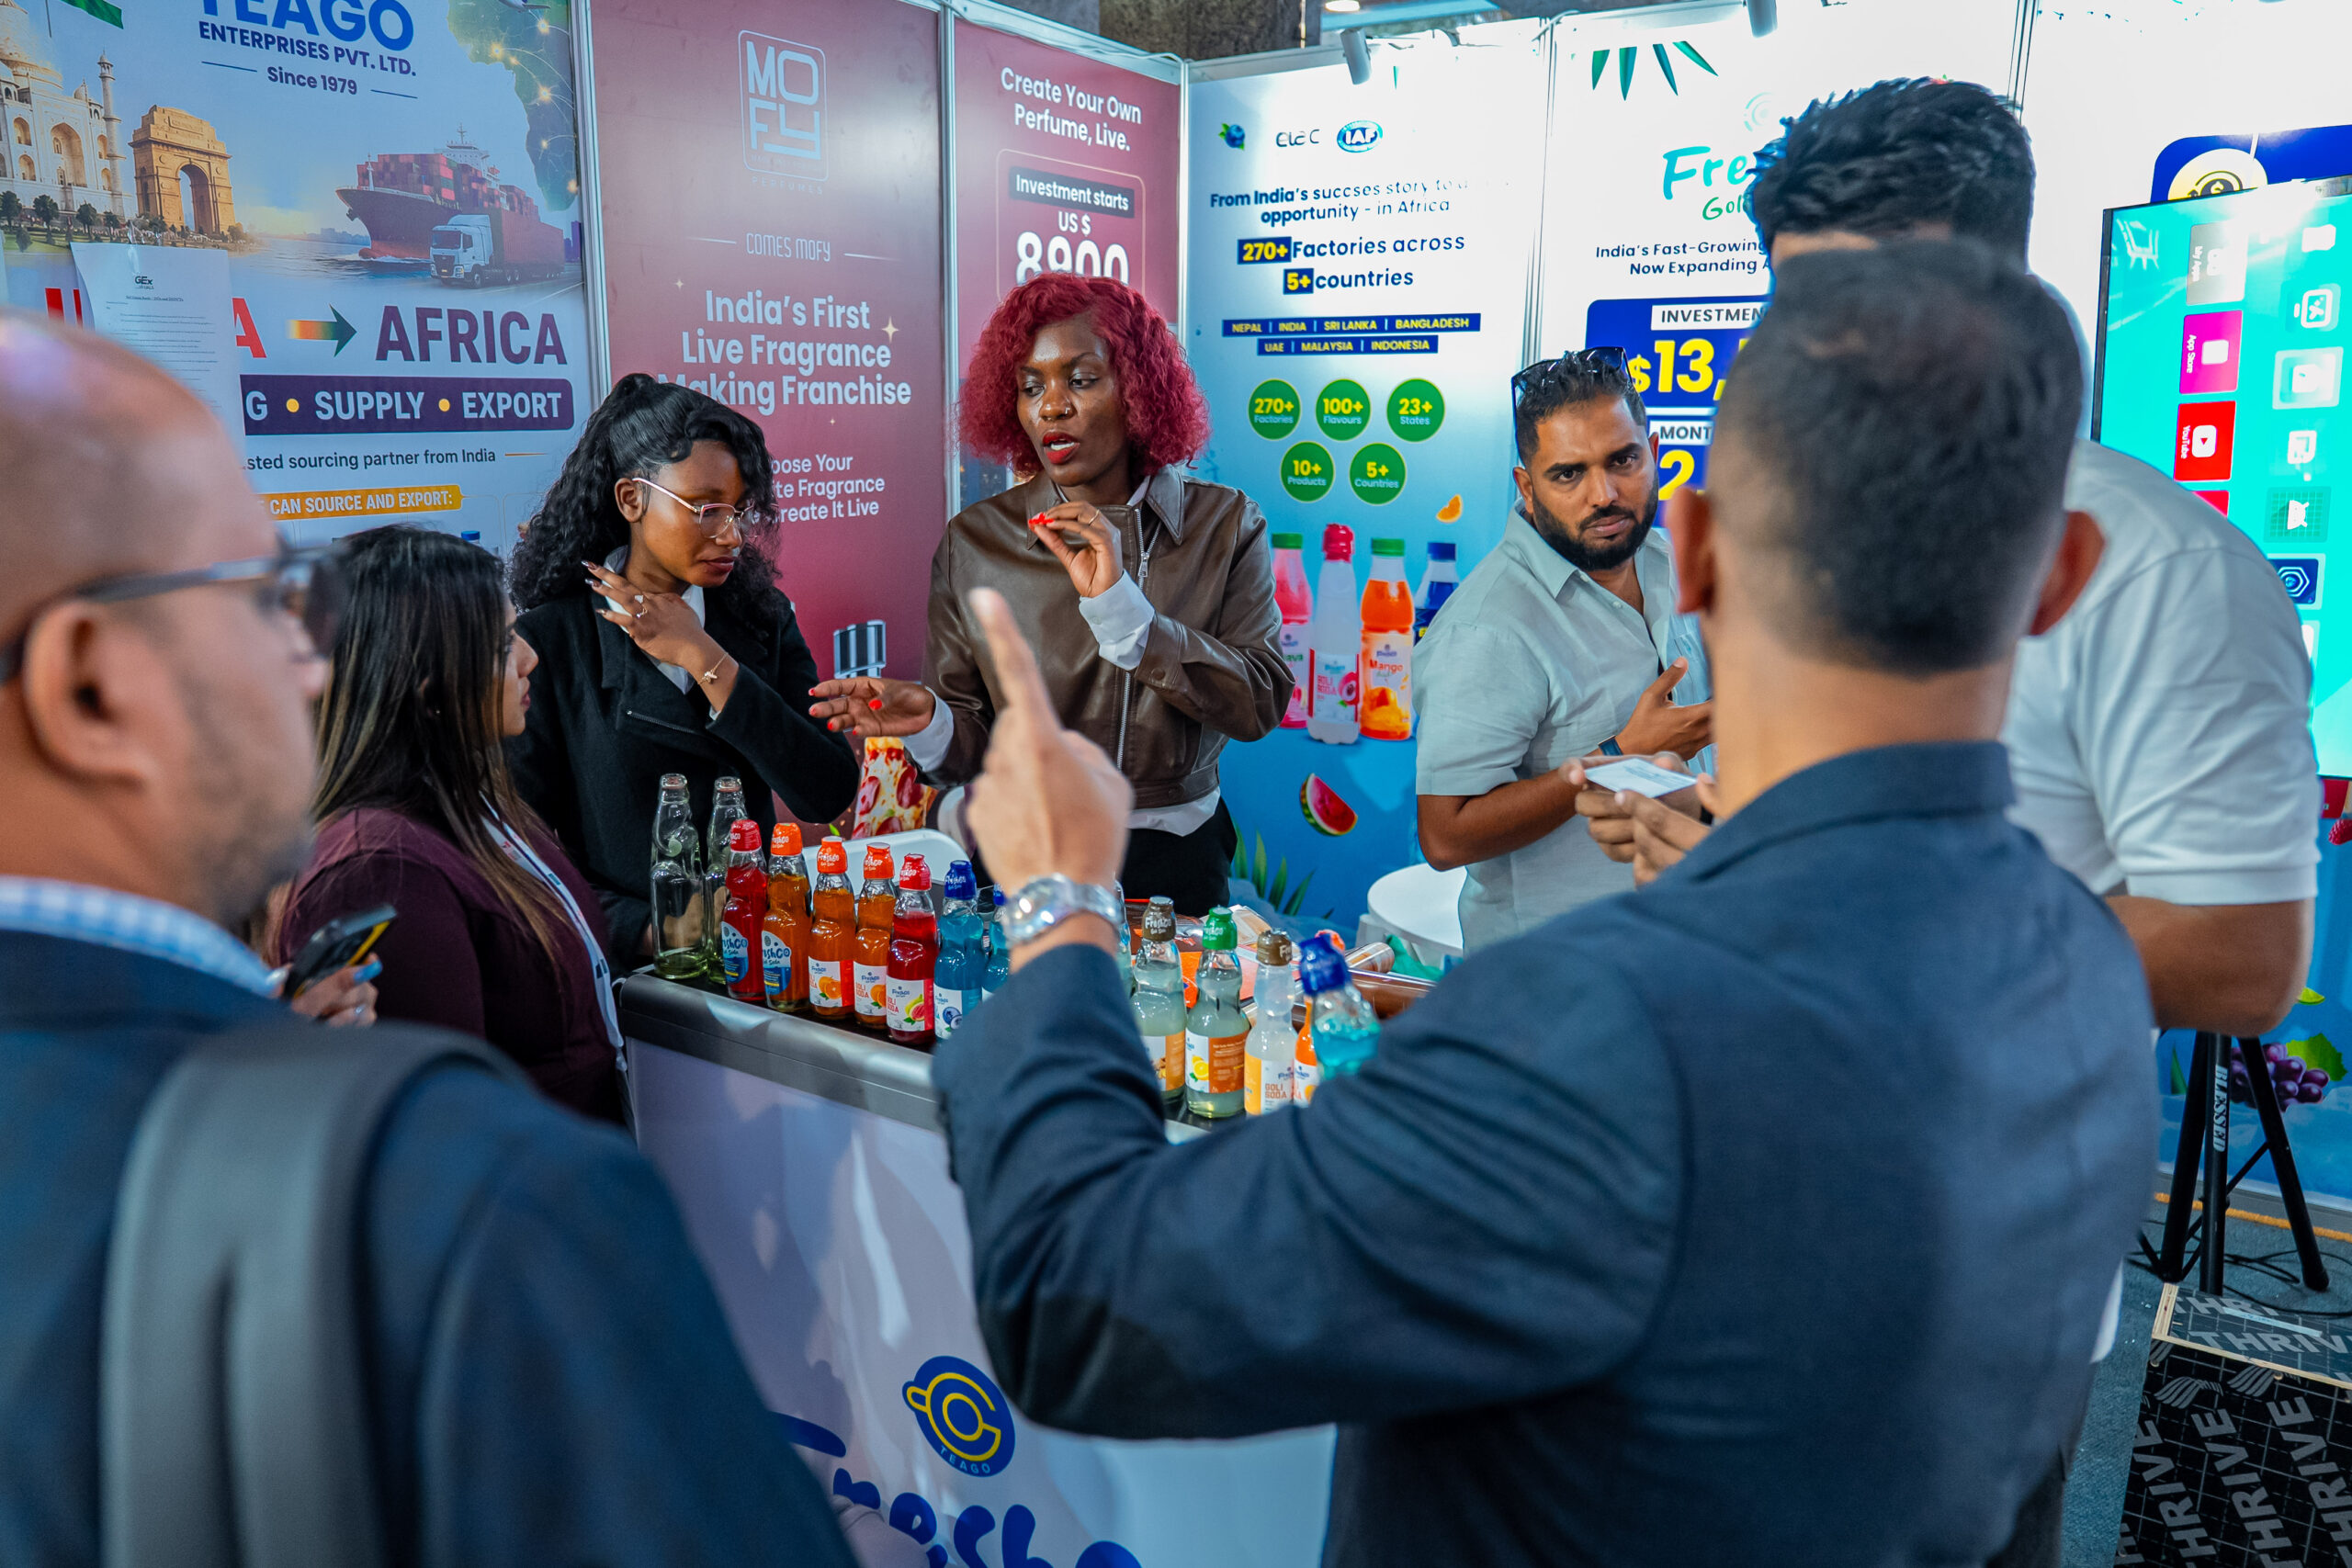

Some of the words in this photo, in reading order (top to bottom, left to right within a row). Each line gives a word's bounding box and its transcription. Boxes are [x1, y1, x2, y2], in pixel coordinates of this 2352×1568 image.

[198, 21, 330, 61] ENTERPRISES
[334, 47, 375, 69] PVT.
[379, 55, 417, 76] LTD.
[267, 67, 317, 88] Since
[321, 75, 357, 95] 1979
[1001, 67, 1062, 103] Create
[1065, 84, 1104, 114] Your
[1107, 96, 1142, 124] Own
[1014, 103, 1092, 146] Perfume,
[1095, 122, 1131, 152] Live.
[1663, 146, 1748, 200] Fre
[1016, 174, 1092, 204] Investment
[1093, 190, 1129, 210] starts
[1210, 193, 1250, 208] From
[1254, 187, 1308, 205] India's
[1313, 185, 1380, 200] succses
[1261, 203, 1359, 227] opportunity
[1377, 200, 1392, 215] in
[1397, 199, 1450, 213] Africa
[1702, 194, 1743, 220] Gol
[1058, 210, 1079, 233] US
[1081, 213, 1091, 236] $
[746, 232, 792, 258] COMES
[796, 238, 831, 262] MOFY
[1243, 243, 1288, 261] 270+
[1293, 236, 1386, 259] Factories
[1393, 236, 1465, 254] across
[1596, 244, 1649, 259] India's
[1629, 262, 1665, 275] Now
[1668, 258, 1757, 277] Expanding
[135, 276, 153, 285] GEx
[1286, 274, 1312, 290] 5+
[1315, 268, 1414, 289] countries
[706, 289, 807, 327] India's
[813, 295, 871, 330] First
[1661, 308, 1765, 322] INVESTMEN
[376, 305, 568, 365] AFRICA
[1232, 323, 1262, 333] NEPAL
[1279, 321, 1306, 332] INDIA
[1324, 321, 1341, 331] SRI
[1342, 320, 1376, 330] LANKA
[1396, 318, 1469, 329] BANGLADESH
[682, 328, 743, 364] Live
[751, 334, 891, 377] Fragrance
[1264, 343, 1284, 353] UAE
[1301, 341, 1353, 351] MALAYSIA
[1371, 340, 1430, 350] INDONESIA
[2187, 334, 2197, 351] App
[2186, 352, 2196, 374] Store
[782, 374, 911, 405] Franchise
[315, 390, 424, 420] SUPPLY
[462, 391, 562, 419] EXPORT
[1254, 398, 1295, 413] 270+
[1323, 398, 1363, 414] 100+
[1399, 398, 1433, 415] 23+
[1254, 414, 1294, 424] Factories
[1323, 415, 1362, 424] Flavours
[1400, 416, 1430, 425] States
[1660, 425, 1713, 440] MONT
[2180, 425, 2190, 459] YouTube
[288, 451, 359, 470] sourcing
[364, 451, 420, 470] partner
[424, 449, 458, 464] from
[462, 448, 496, 463] India
[815, 454, 854, 472] Your
[1293, 460, 1322, 476] 10+
[1366, 462, 1389, 478] 5+
[798, 478, 886, 500] Fragrance
[1287, 476, 1327, 486] Products
[1354, 479, 1399, 489] Countries
[269, 499, 301, 515] CAN
[305, 494, 363, 514] SOURCE
[366, 492, 395, 510] AND
[398, 491, 453, 508] EXPORT:
[775, 502, 829, 523] reate
[831, 501, 844, 518] It
[847, 498, 879, 517] Live
[1370, 660, 1404, 673] Mango
[1265, 1083, 1283, 1092] GOLI
[1265, 1091, 1287, 1100] SODA
[2188, 1331, 2352, 1354] THRIV
[940, 1445, 991, 1474] TEAGO
